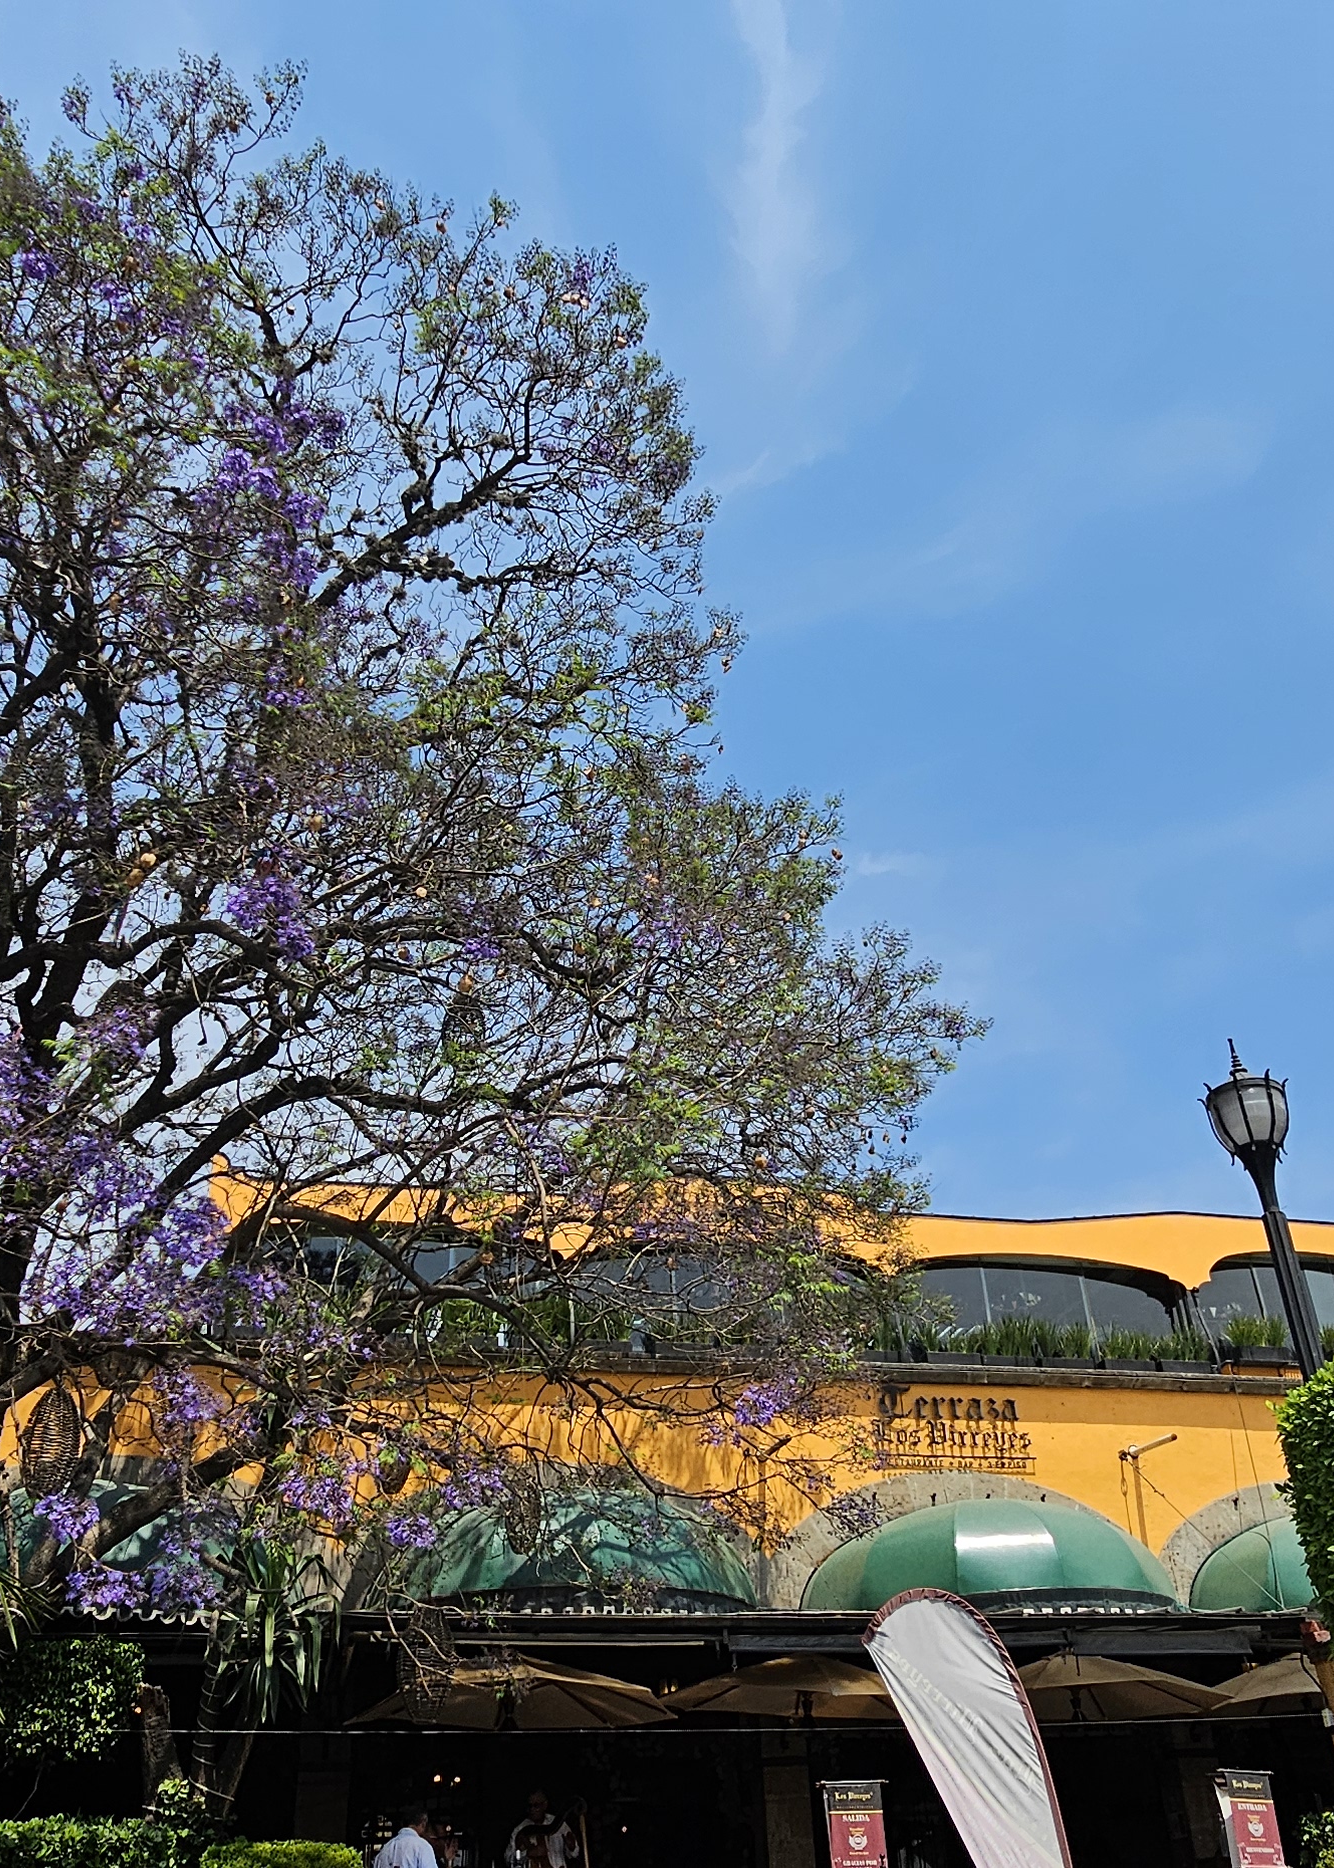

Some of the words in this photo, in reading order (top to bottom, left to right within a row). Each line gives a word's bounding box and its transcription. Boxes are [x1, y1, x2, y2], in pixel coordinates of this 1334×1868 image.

[878, 1383, 1019, 1421] Terraza
[872, 1419, 922, 1446] Los
[925, 1420, 1032, 1457] Virreyes
[1238, 1803, 1267, 1811] ENTRADA
